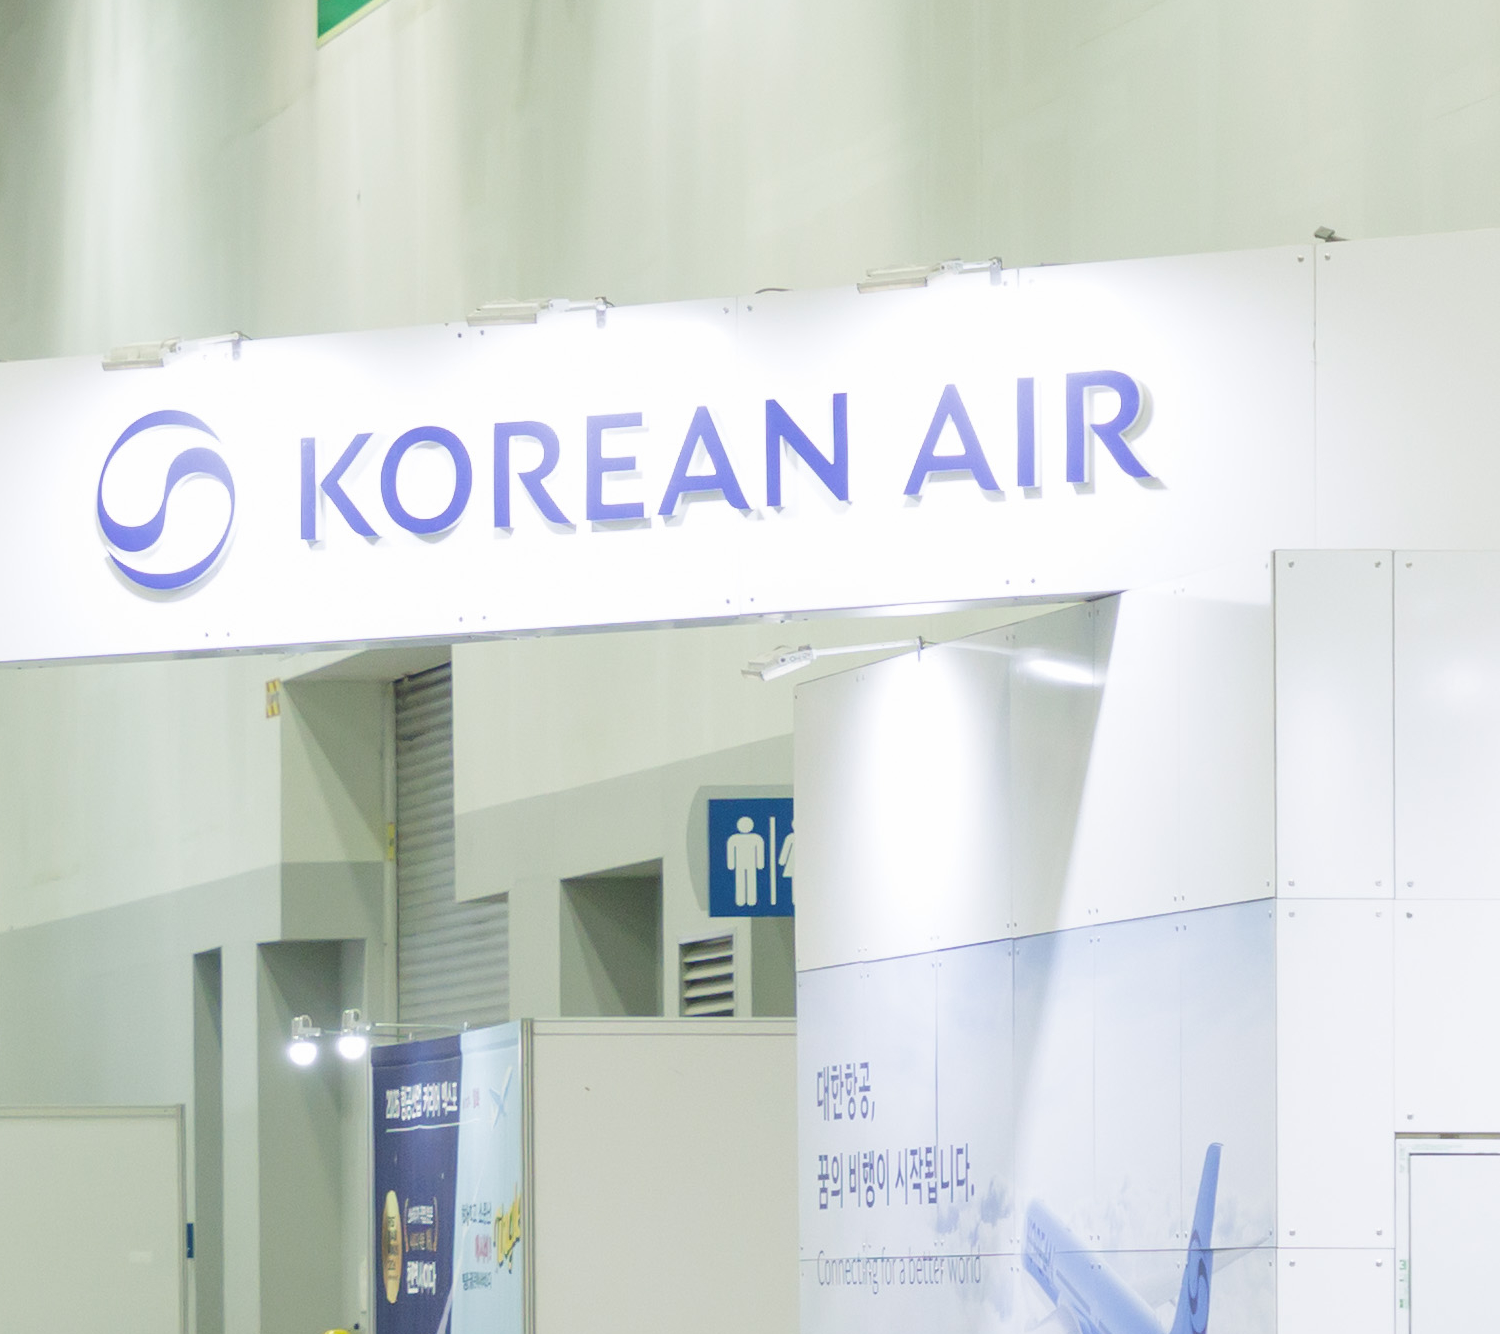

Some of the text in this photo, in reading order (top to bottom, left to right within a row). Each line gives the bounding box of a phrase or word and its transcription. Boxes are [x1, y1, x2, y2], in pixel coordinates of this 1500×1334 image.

[300, 370, 1157, 541] KOREAN AIR
[817, 1062, 875, 1122] 대한항공,
[817, 1152, 844, 1210] 꿈의
[848, 1149, 890, 1208] 비행이
[817, 1247, 879, 1295] Connecting
[881, 1247, 896, 1285] for
[900, 1257, 906, 1285] a
[909, 1247, 944, 1285] better
[948, 1244, 982, 1285] world
